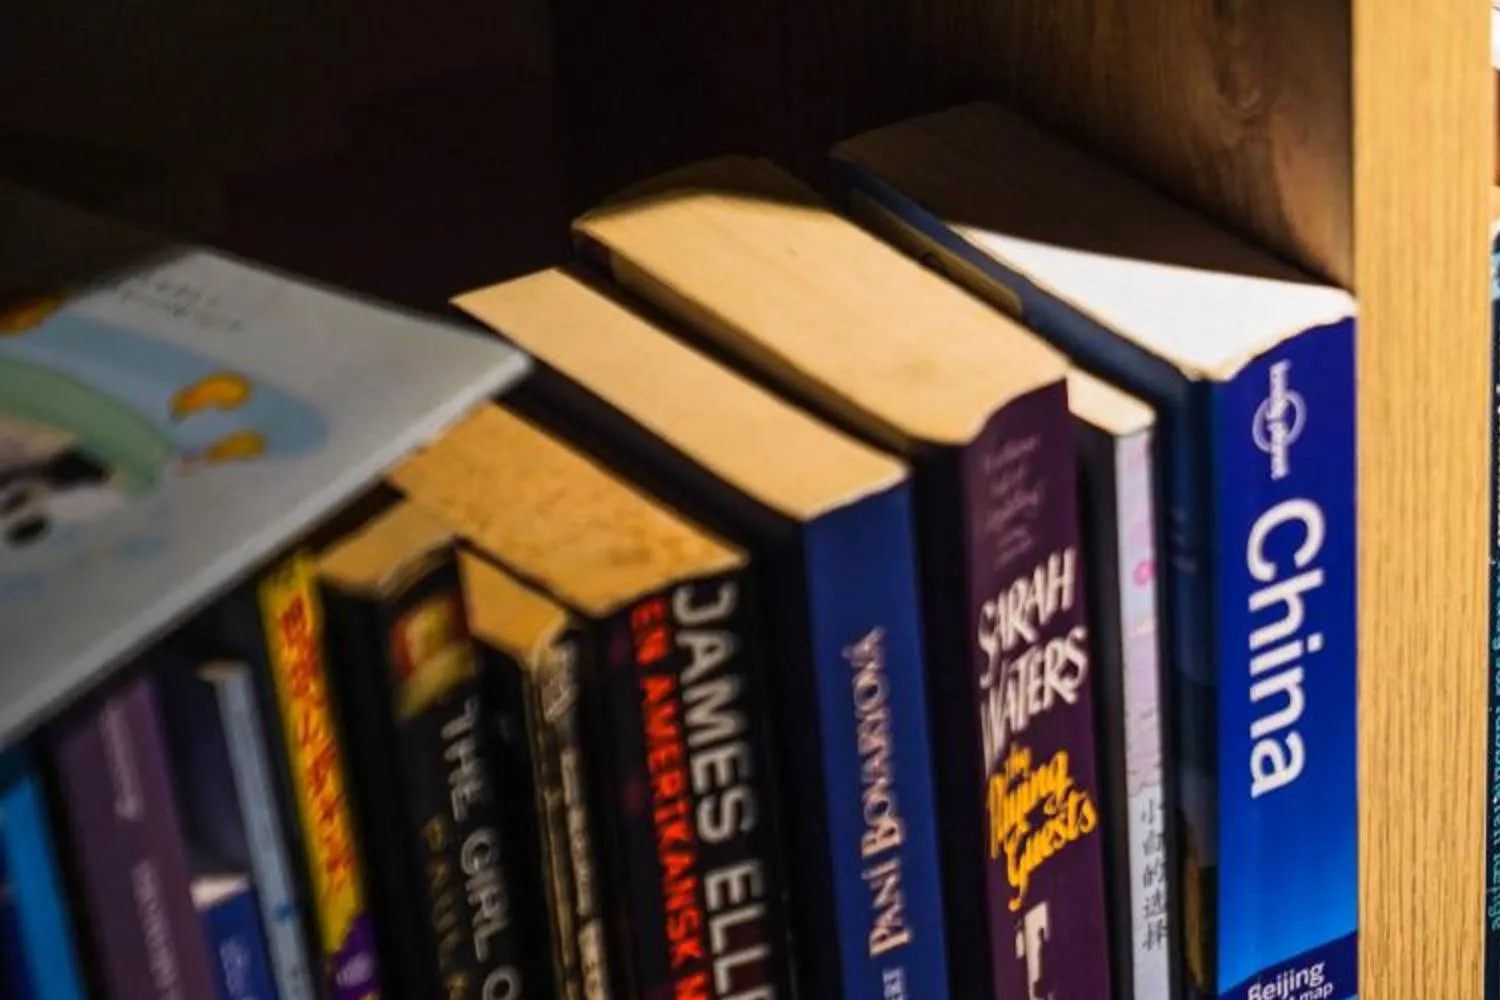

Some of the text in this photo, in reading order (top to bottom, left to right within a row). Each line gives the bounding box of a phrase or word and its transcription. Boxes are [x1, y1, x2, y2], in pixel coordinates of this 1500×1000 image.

[629, 600, 668, 664] EN
[981, 626, 1088, 775] WATERS
[1246, 498, 1325, 799] China
[440, 699, 482, 824] THE
[673, 580, 757, 844] JAMES
[459, 825, 509, 963] GIRL
[640, 670, 707, 970] AMERIKANSK
